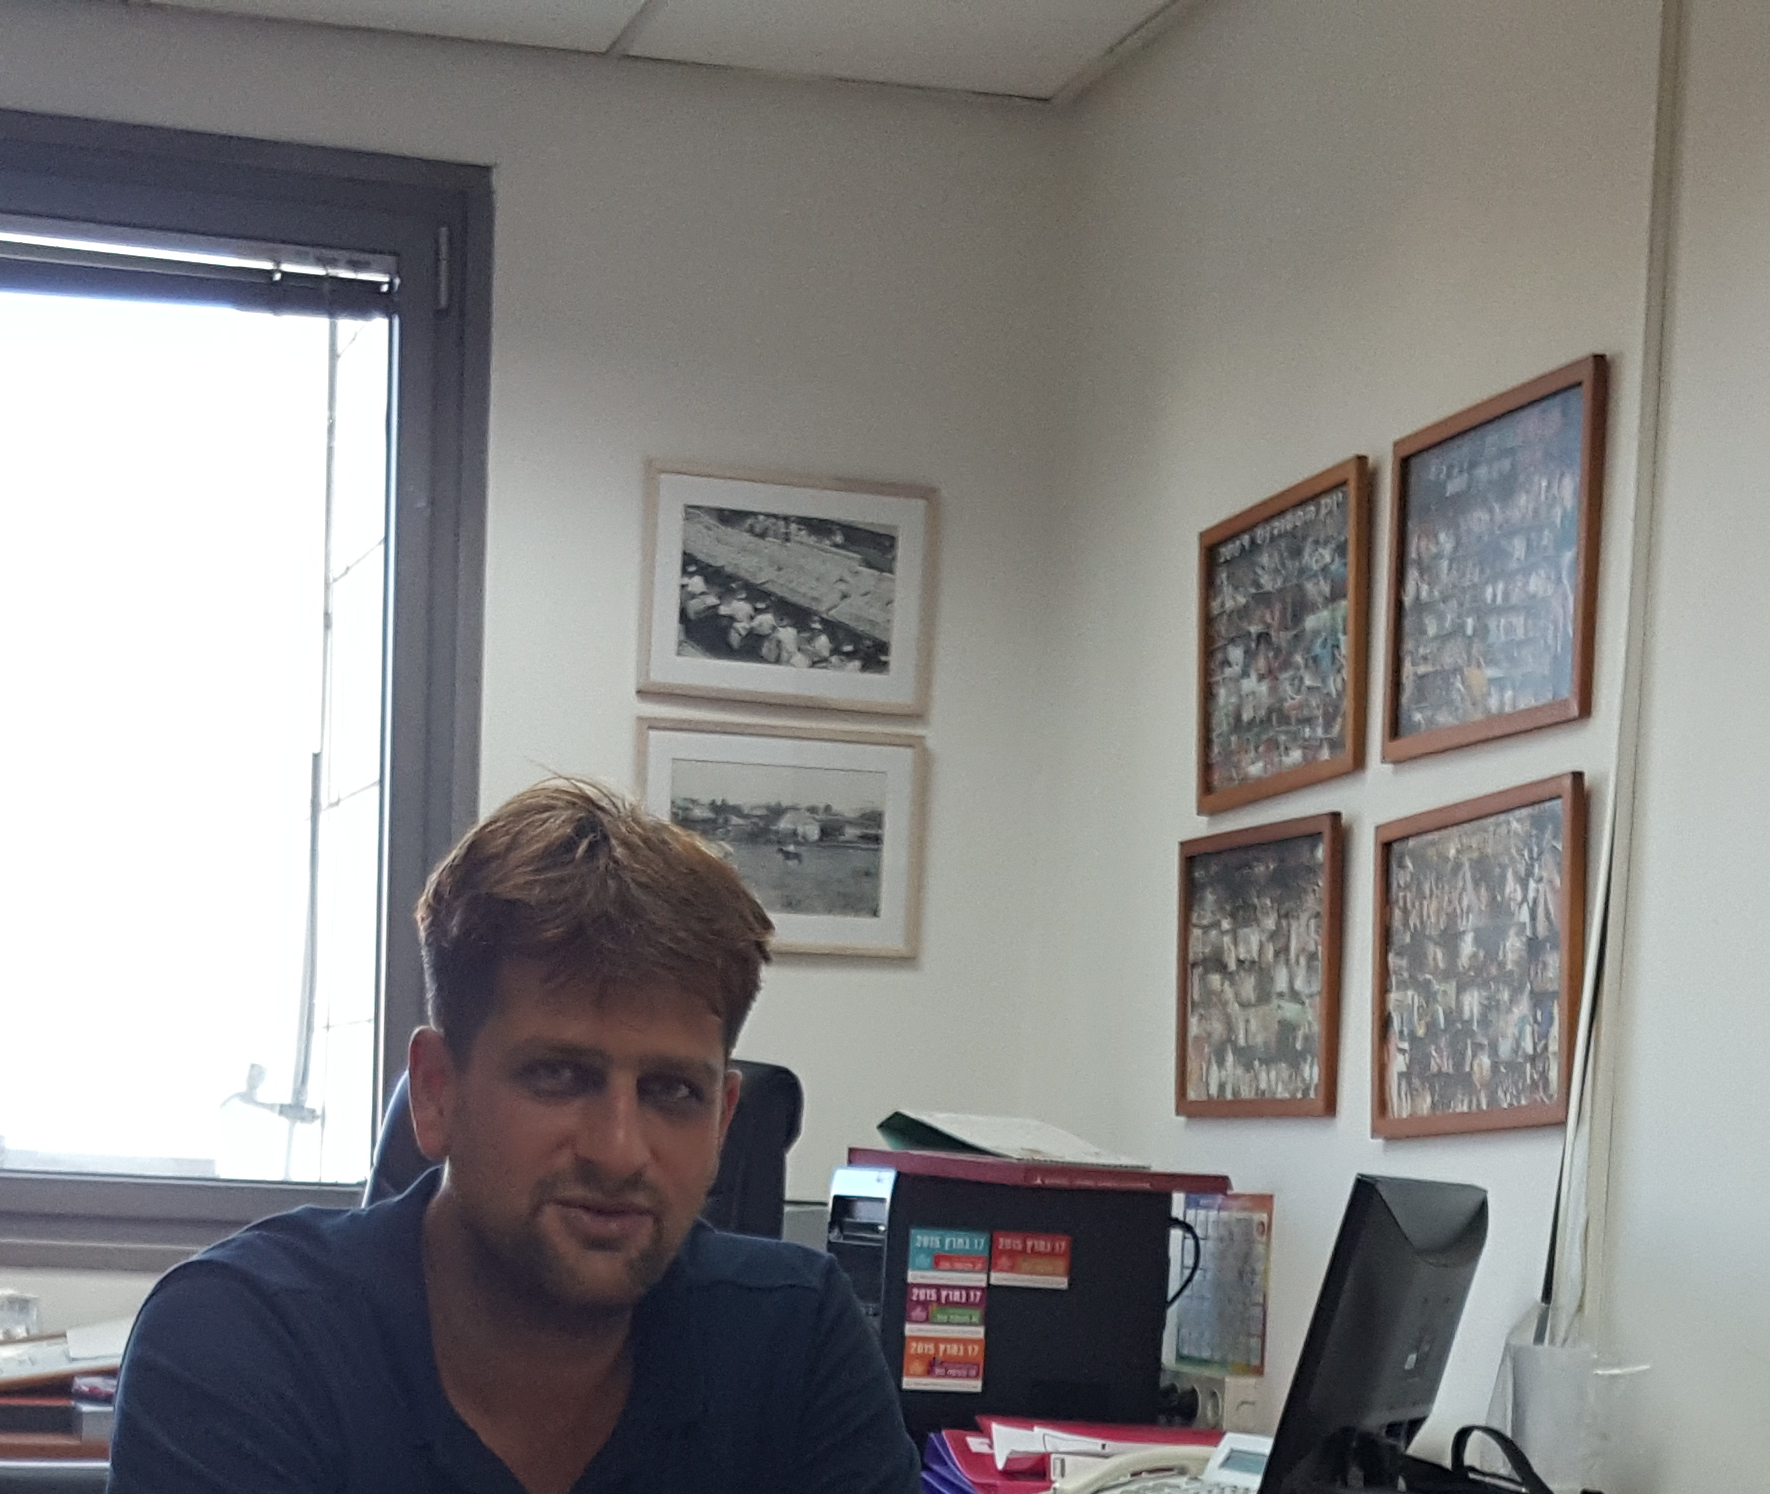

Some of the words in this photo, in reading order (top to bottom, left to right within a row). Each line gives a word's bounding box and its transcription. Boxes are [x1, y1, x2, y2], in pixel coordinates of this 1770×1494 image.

[916, 1234, 941, 1248] 2015
[998, 1237, 1023, 1250] 2015
[911, 1288, 937, 1301] 2015
[910, 1342, 935, 1354] 2015
